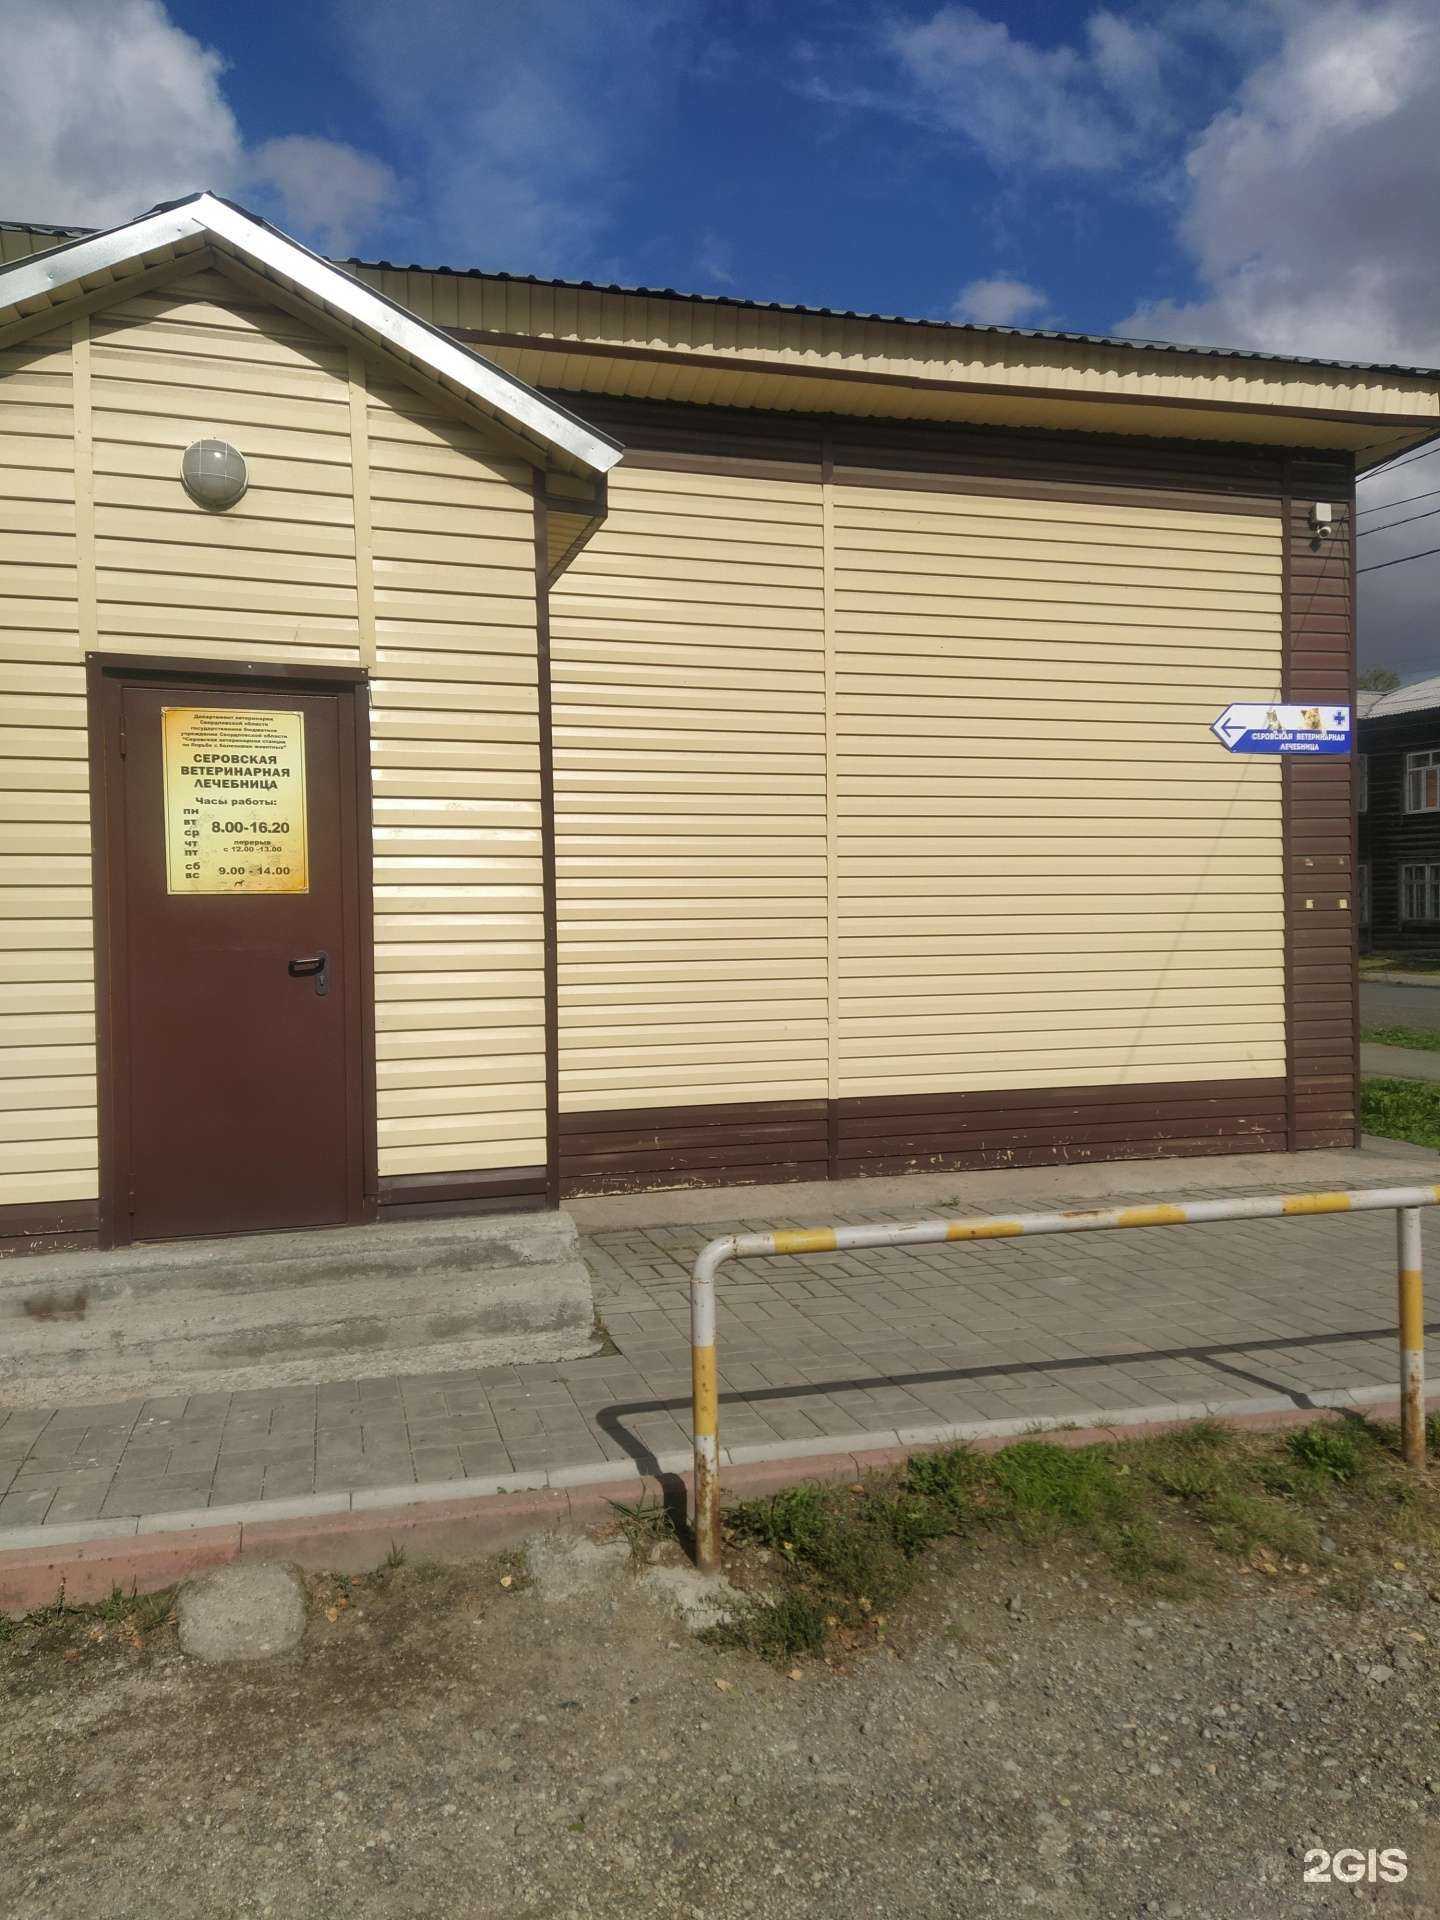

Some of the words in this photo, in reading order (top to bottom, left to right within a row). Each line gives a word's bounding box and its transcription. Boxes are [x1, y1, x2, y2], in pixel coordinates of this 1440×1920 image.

[1296, 733, 1345, 741] ВЕТЕРИНАРНАЯ
[1280, 743, 1319, 751] ЛЕЧЕБНИЦА
[193, 754, 277, 764] СЕРОВСКАЯ
[181, 766, 290, 777] ВЕТЕРИНАРНАЯ
[194, 779, 278, 791] ЛЕЧЕБНИЦА
[195, 797, 227, 805] Часы
[231, 798, 277, 806] работы:
[211, 821, 290, 834] 8.00-16.20
[184, 830, 200, 838] ср
[185, 862, 201, 870] сб
[218, 867, 245, 875] 9.00
[257, 867, 290, 875] 14.00
